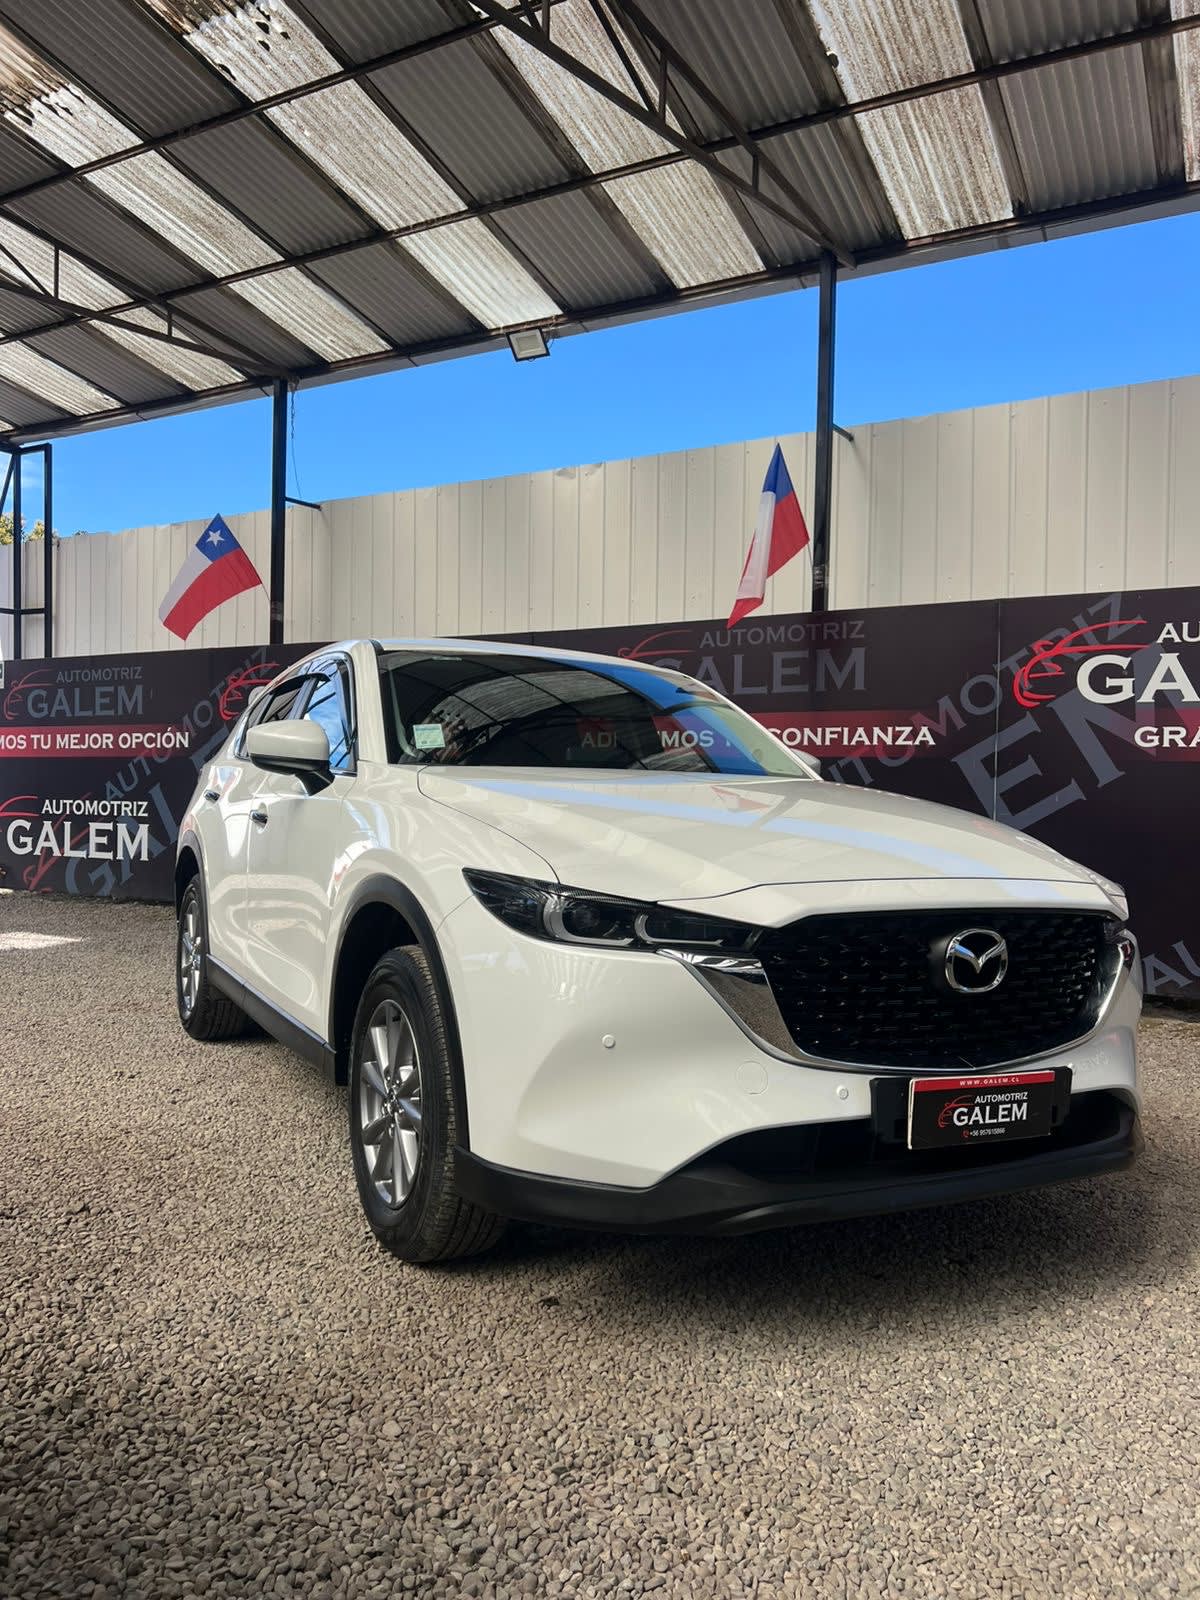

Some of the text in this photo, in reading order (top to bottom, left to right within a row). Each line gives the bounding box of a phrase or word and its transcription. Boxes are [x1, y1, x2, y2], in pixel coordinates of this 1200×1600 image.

[700, 620, 865, 648] AUTOMOTRIZ
[56, 666, 143, 684] AUTOMOTRIZ
[27, 684, 144, 719] GALEM
[30, 734, 52, 749] TU
[56, 733, 112, 750] MEJOR
[118, 727, 190, 749] OPCIÓN
[41, 799, 149, 817] AUTOMOTRIZ
[6, 819, 150, 862] GALEM
[974, 1092, 1028, 1104] AUTOMOTRIZ
[953, 1102, 1028, 1127] GALEM
